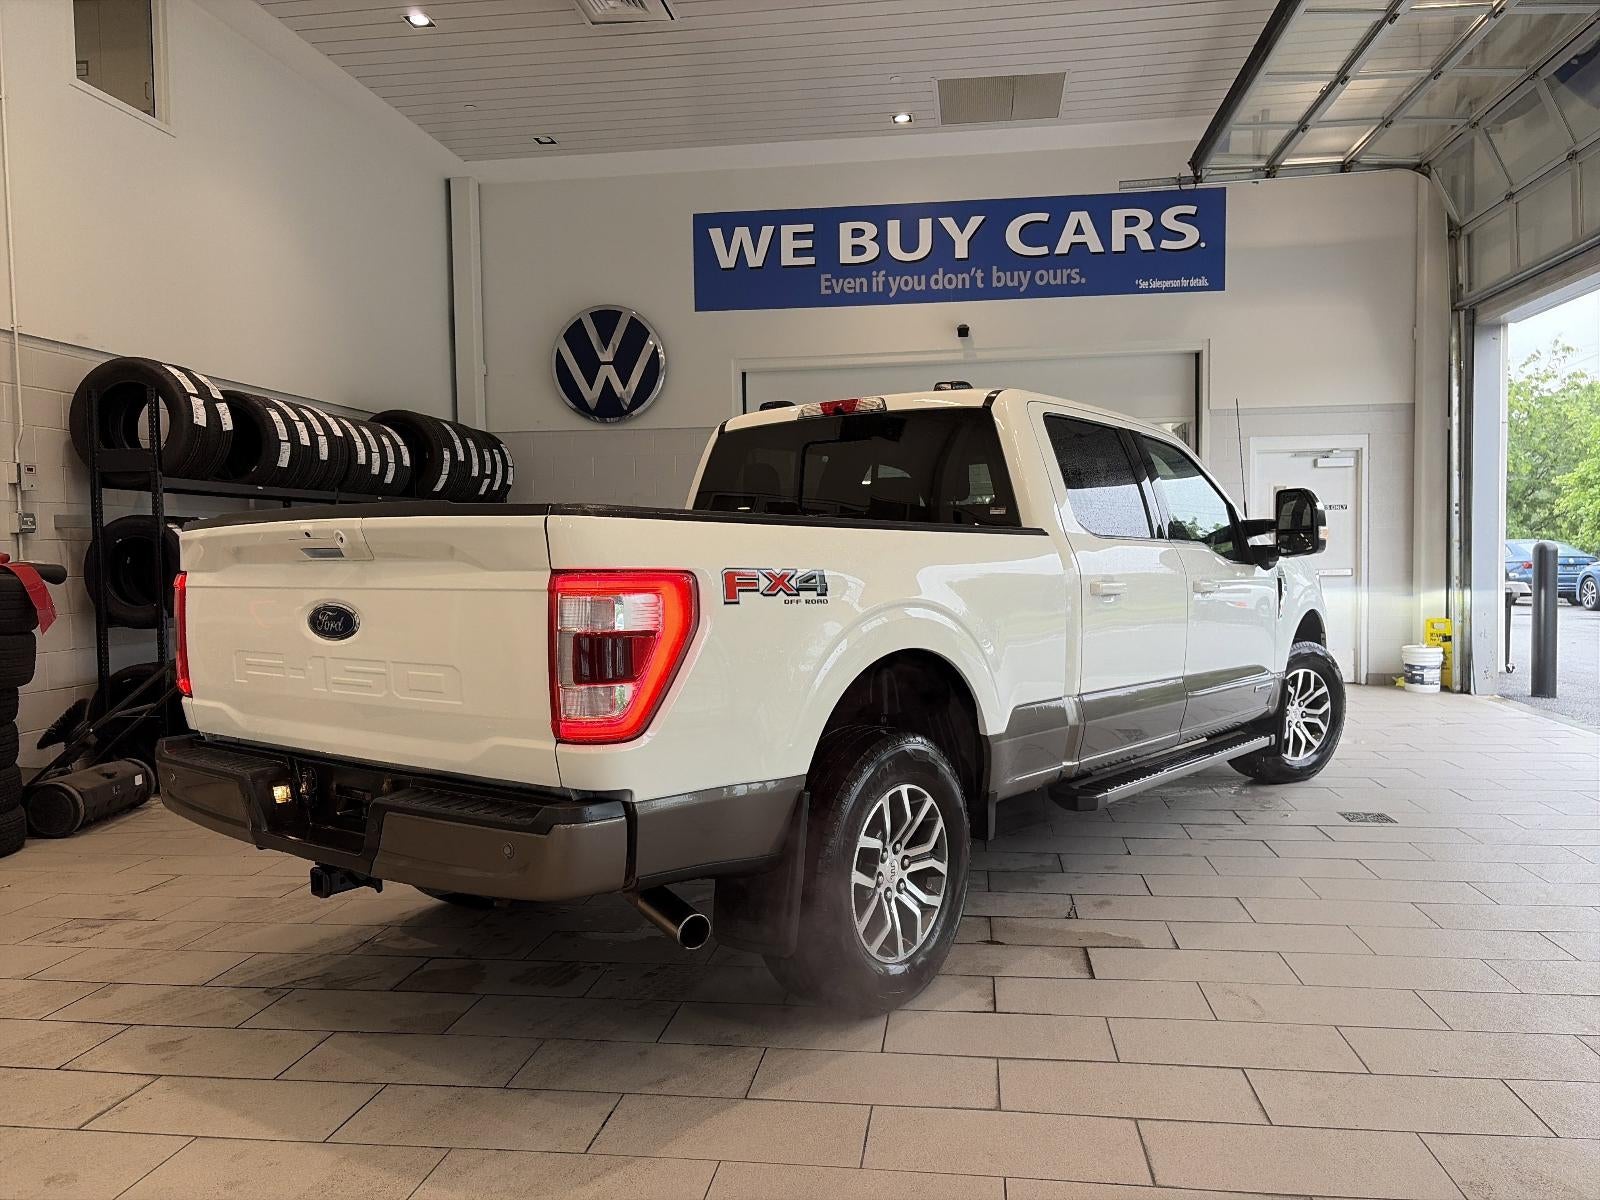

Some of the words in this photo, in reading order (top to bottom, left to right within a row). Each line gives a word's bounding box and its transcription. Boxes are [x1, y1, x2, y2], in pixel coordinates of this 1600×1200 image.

[708, 223, 816, 269] WE
[839, 216, 986, 265] BUY
[1005, 205, 1206, 256] CARS.
[820, 273, 868, 295] Even
[872, 270, 885, 292] if
[888, 274, 926, 298] you
[930, 266, 985, 290] don’t
[991, 265, 1036, 293] buy
[1034, 268, 1087, 286] ours.
[1149, 278, 1181, 291] Salesperson
[1180, 276, 1190, 287] for
[721, 567, 829, 605] FX4
[316, 610, 345, 632] Ford
[233, 650, 463, 705] F-150
